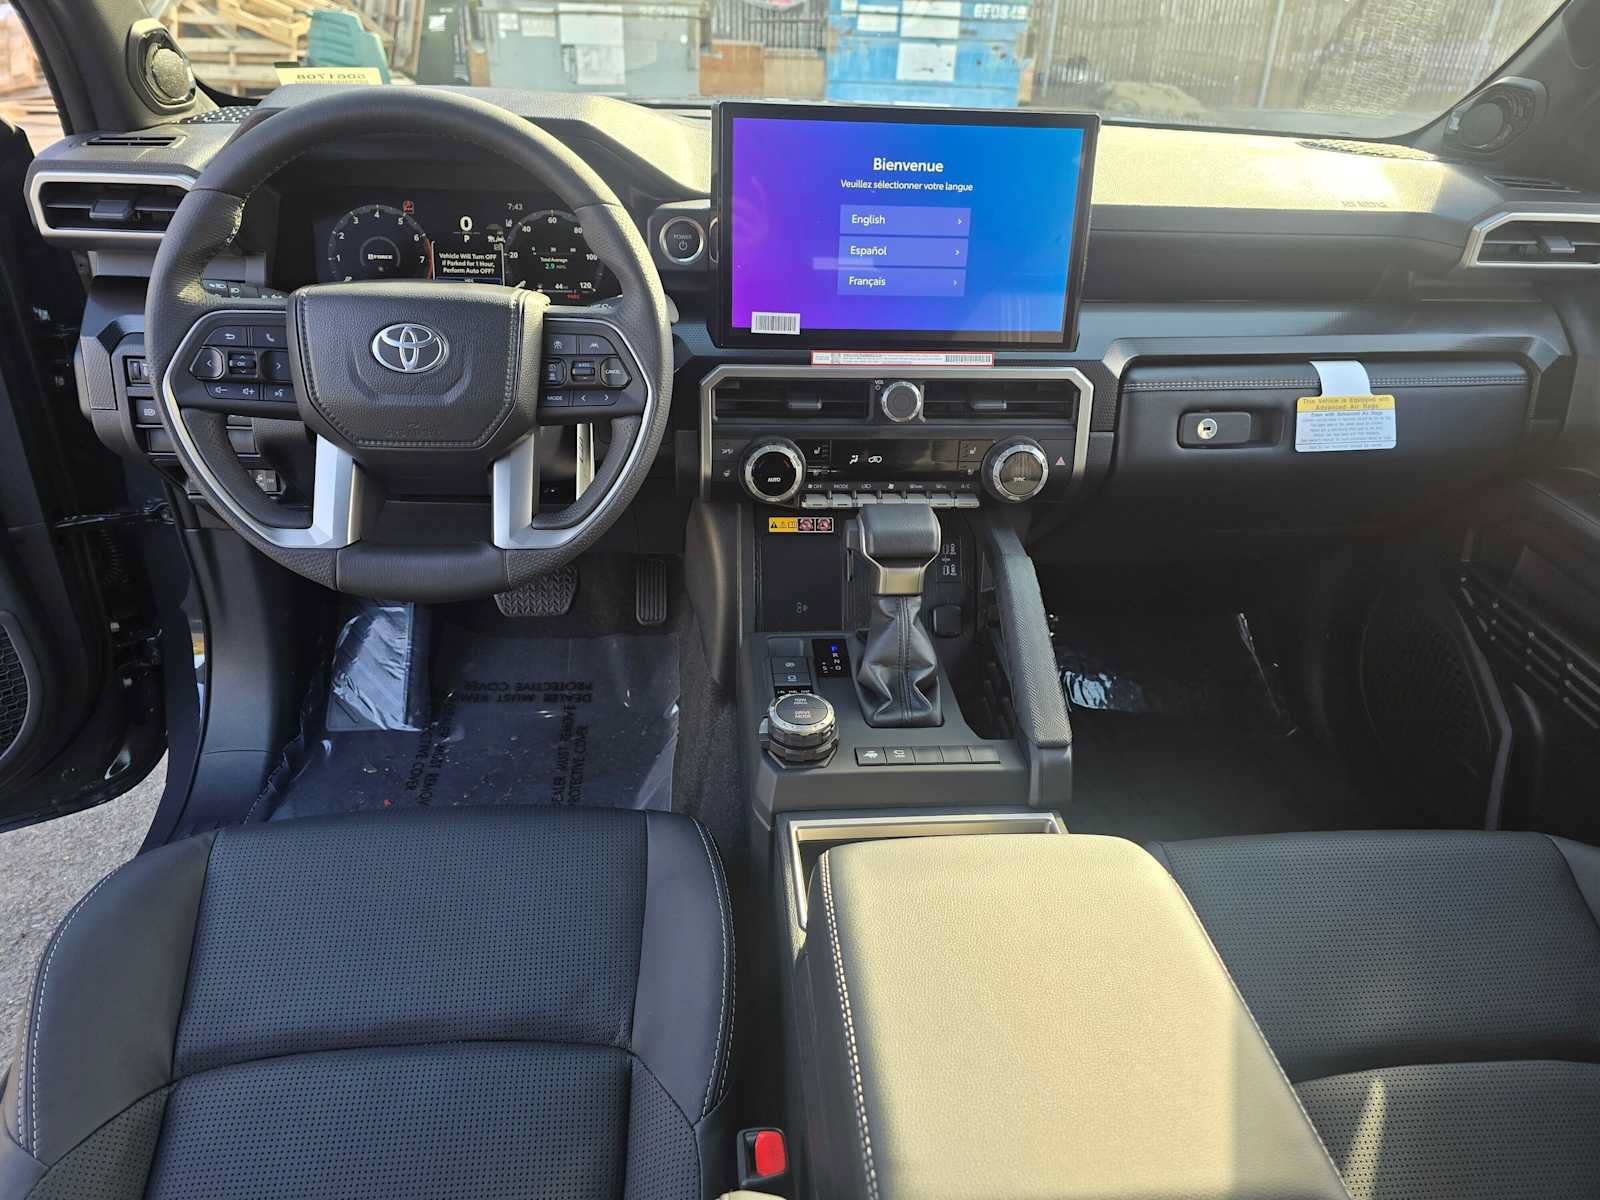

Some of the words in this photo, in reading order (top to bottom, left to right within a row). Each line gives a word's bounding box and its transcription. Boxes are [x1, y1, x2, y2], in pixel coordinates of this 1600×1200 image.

[872, 157, 944, 172] Bienvenue
[841, 179, 872, 189] Veuillez
[873, 180, 923, 190] sélectionner
[924, 182, 944, 191] votre
[945, 182, 973, 193] langue
[353, 216, 359, 224] 3
[398, 217, 404, 225] 5
[460, 215, 473, 231] 0
[851, 214, 886, 226] English
[574, 226, 583, 234] 80
[464, 235, 470, 243] P
[850, 245, 887, 257] Español
[849, 276, 886, 288] Français
